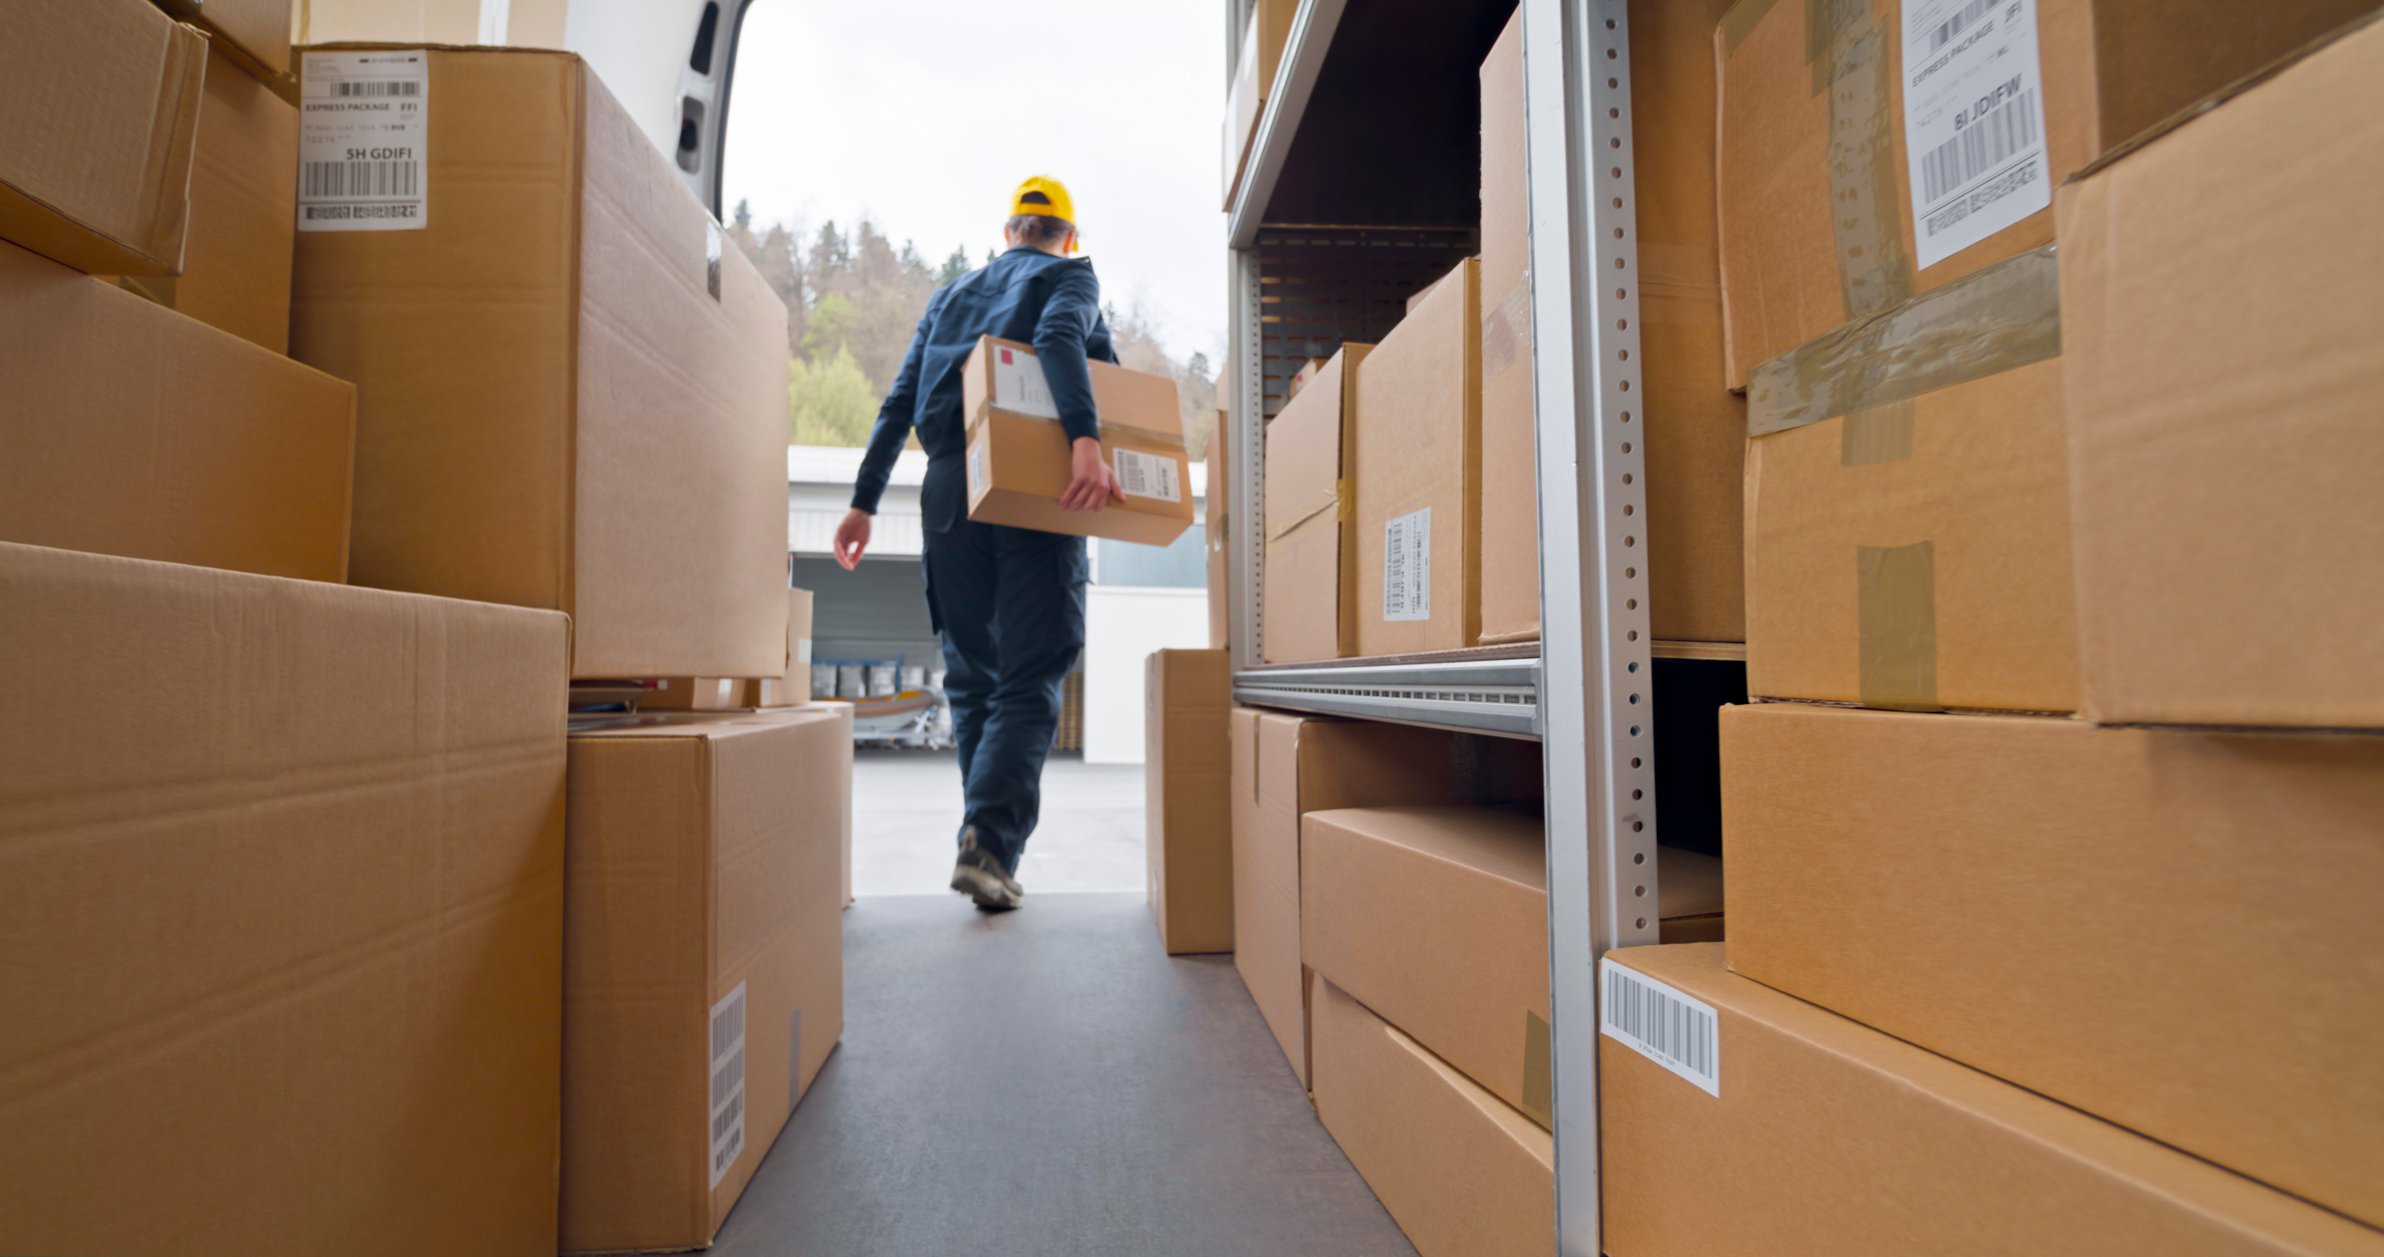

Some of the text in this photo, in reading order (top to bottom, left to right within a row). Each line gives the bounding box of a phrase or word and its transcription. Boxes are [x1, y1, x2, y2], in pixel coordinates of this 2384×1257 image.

[1912, 53, 1949, 88] EXPRESS
[1951, 20, 1993, 58] PACKAGE
[305, 102, 391, 112] EXPRESS PACKAGE
[1971, 72, 2022, 122] JDIFW
[370, 147, 412, 160] GDIFI
